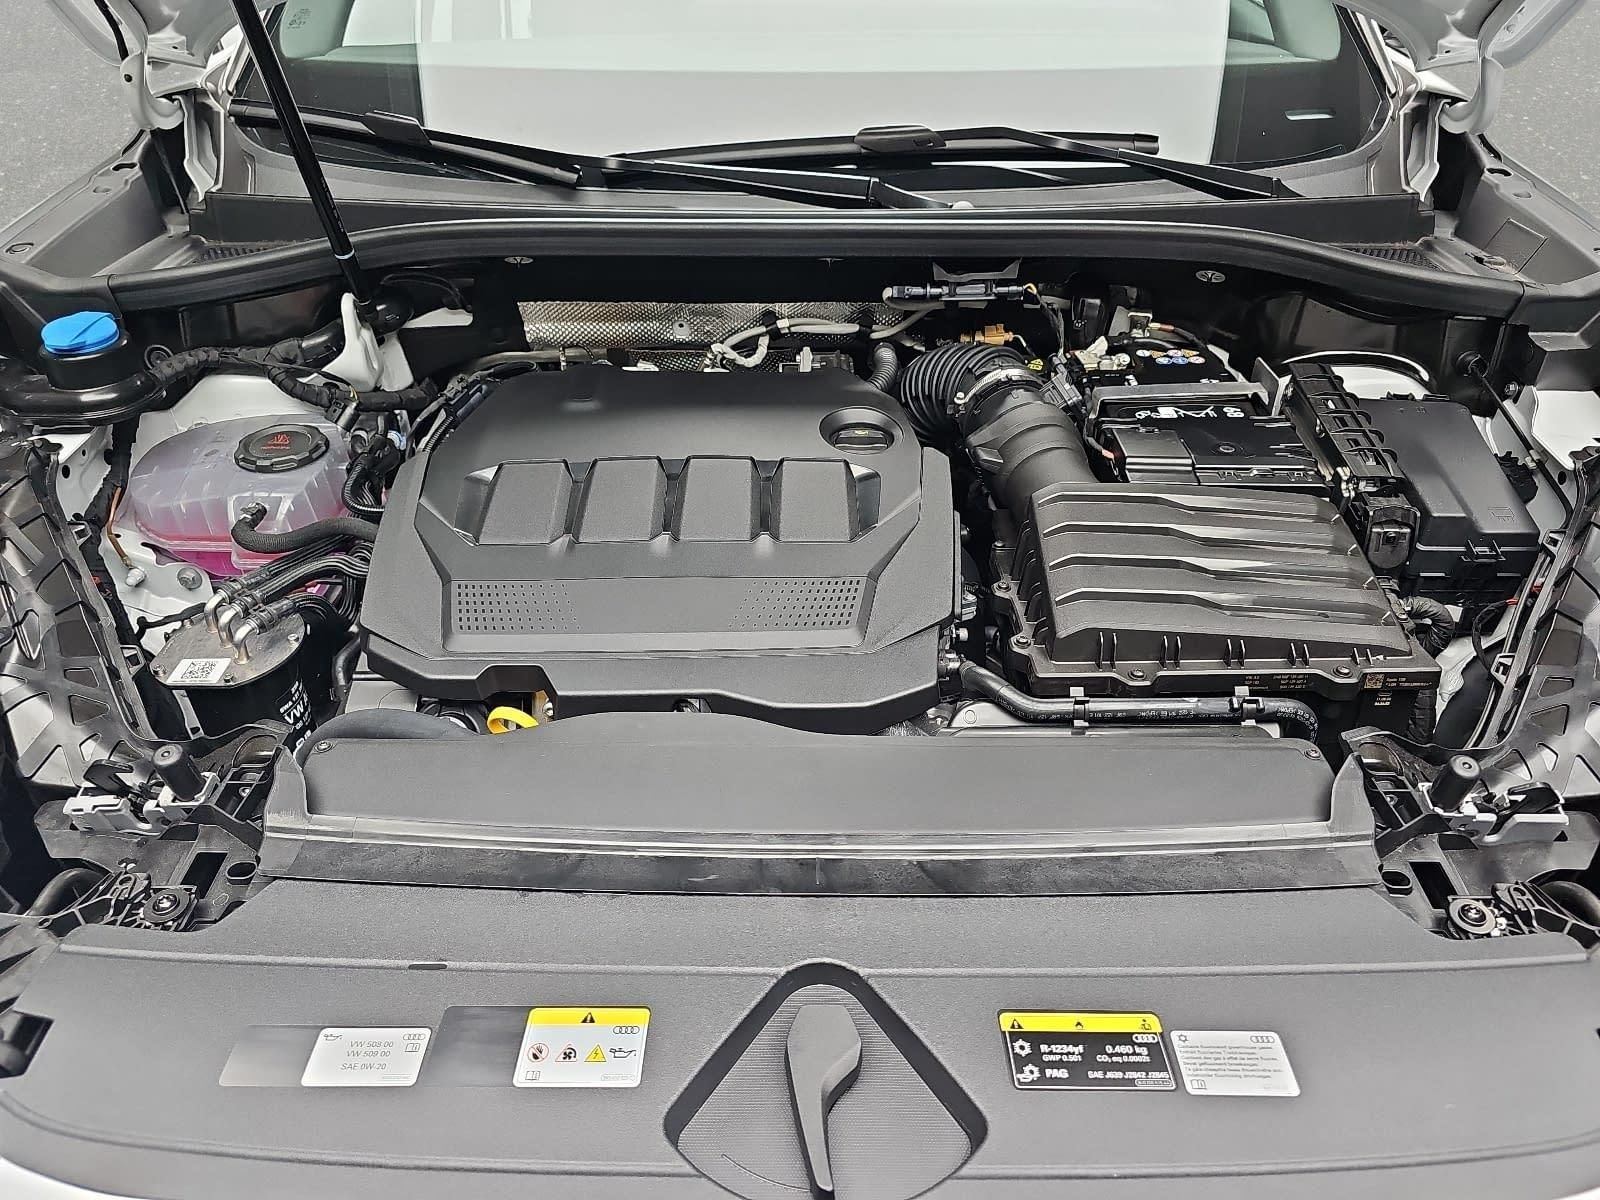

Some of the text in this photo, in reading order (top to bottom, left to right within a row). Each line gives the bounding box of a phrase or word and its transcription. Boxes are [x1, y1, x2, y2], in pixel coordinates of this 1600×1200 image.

[284, 700, 304, 724] VW
[350, 1040, 365, 1048] VW
[384, 1040, 394, 1048] 00
[346, 1050, 391, 1058] VW 509 00
[1040, 1044, 1084, 1055] R-1234yf
[1134, 1045, 1148, 1056] kg
[340, 1062, 359, 1071] SAE
[1045, 1069, 1069, 1079] PAG
[1087, 1070, 1104, 1079] SAE
